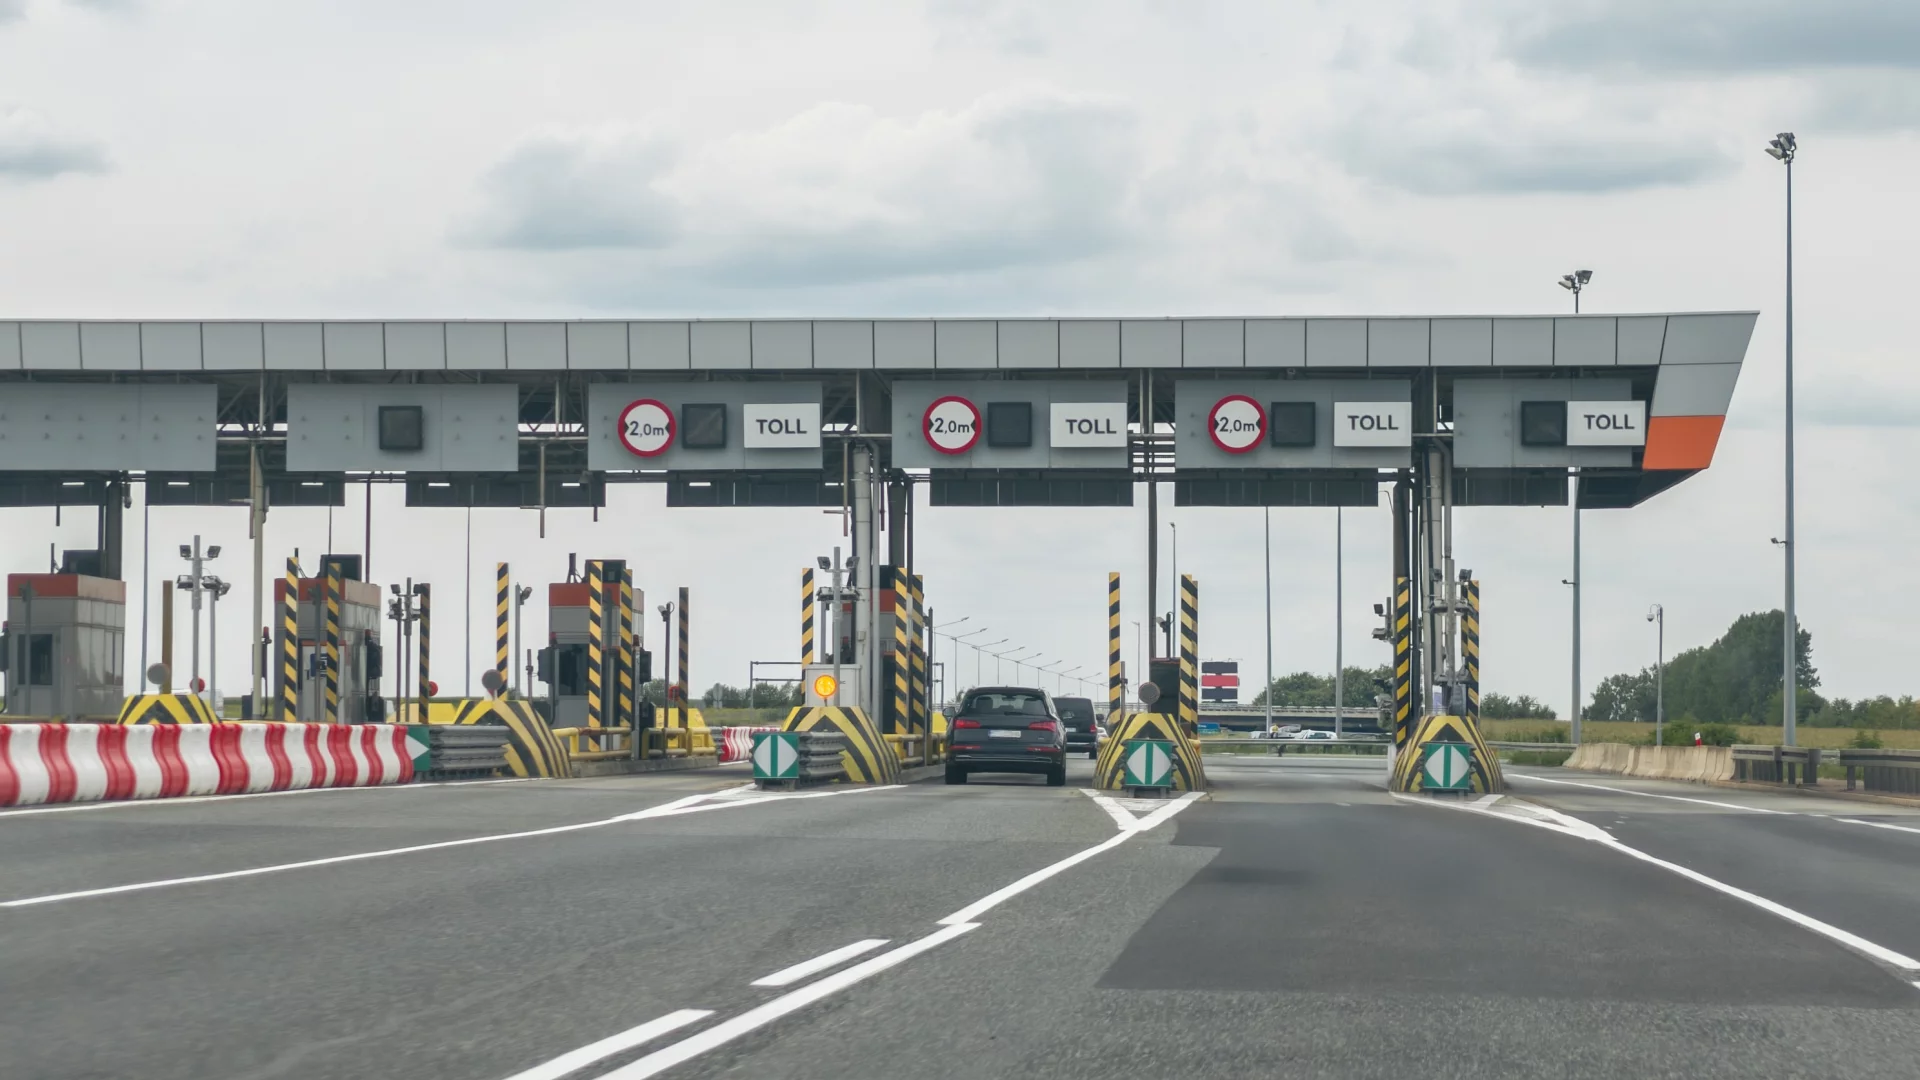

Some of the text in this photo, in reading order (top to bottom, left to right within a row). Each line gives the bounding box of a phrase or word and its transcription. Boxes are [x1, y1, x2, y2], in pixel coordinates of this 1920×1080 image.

[629, 420, 665, 438] 2,0m
[755, 418, 808, 435] TOLL
[934, 417, 970, 435] 2,0m
[1066, 418, 1117, 435] TOLL
[1219, 416, 1255, 434] 2,0m
[1347, 414, 1399, 431] TOLL
[1583, 414, 1636, 430] TOLL
